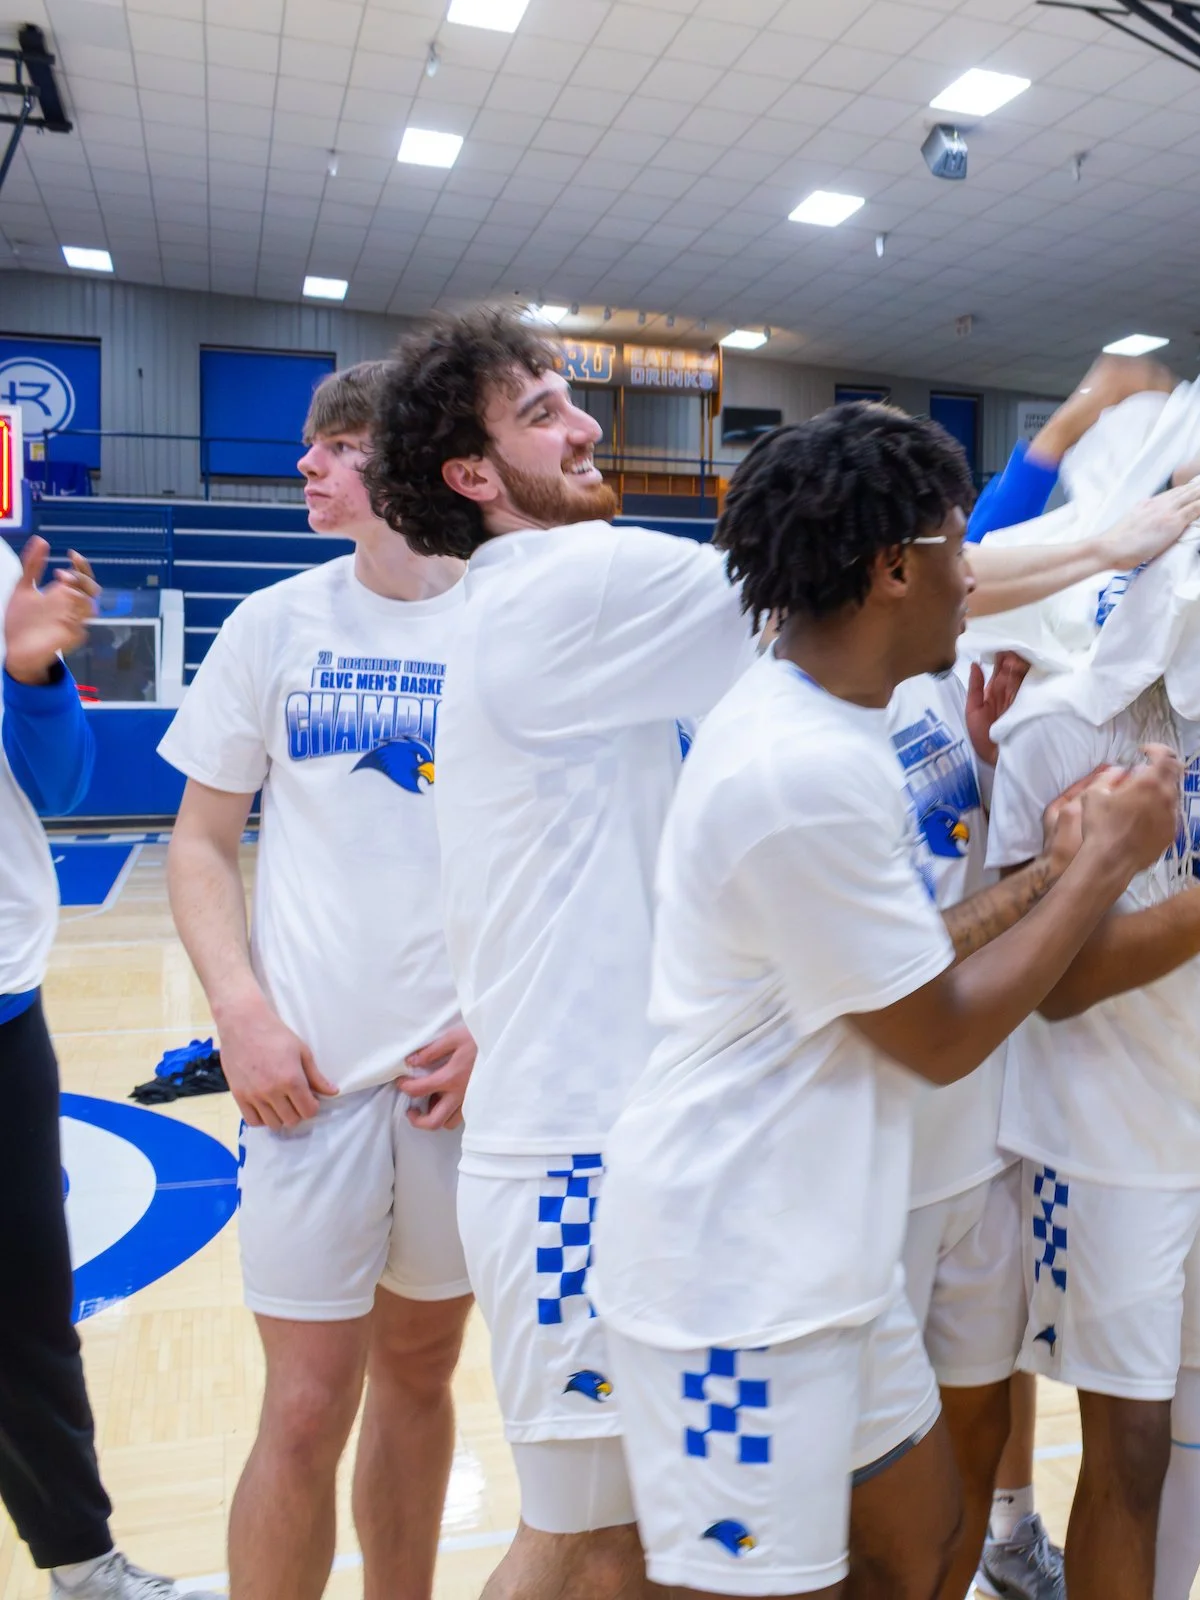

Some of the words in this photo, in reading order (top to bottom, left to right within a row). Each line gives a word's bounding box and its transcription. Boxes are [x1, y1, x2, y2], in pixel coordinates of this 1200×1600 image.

[630, 367, 713, 389] DRINKS
[320, 671, 353, 689] GLVC
[356, 673, 397, 692] MEN'S
